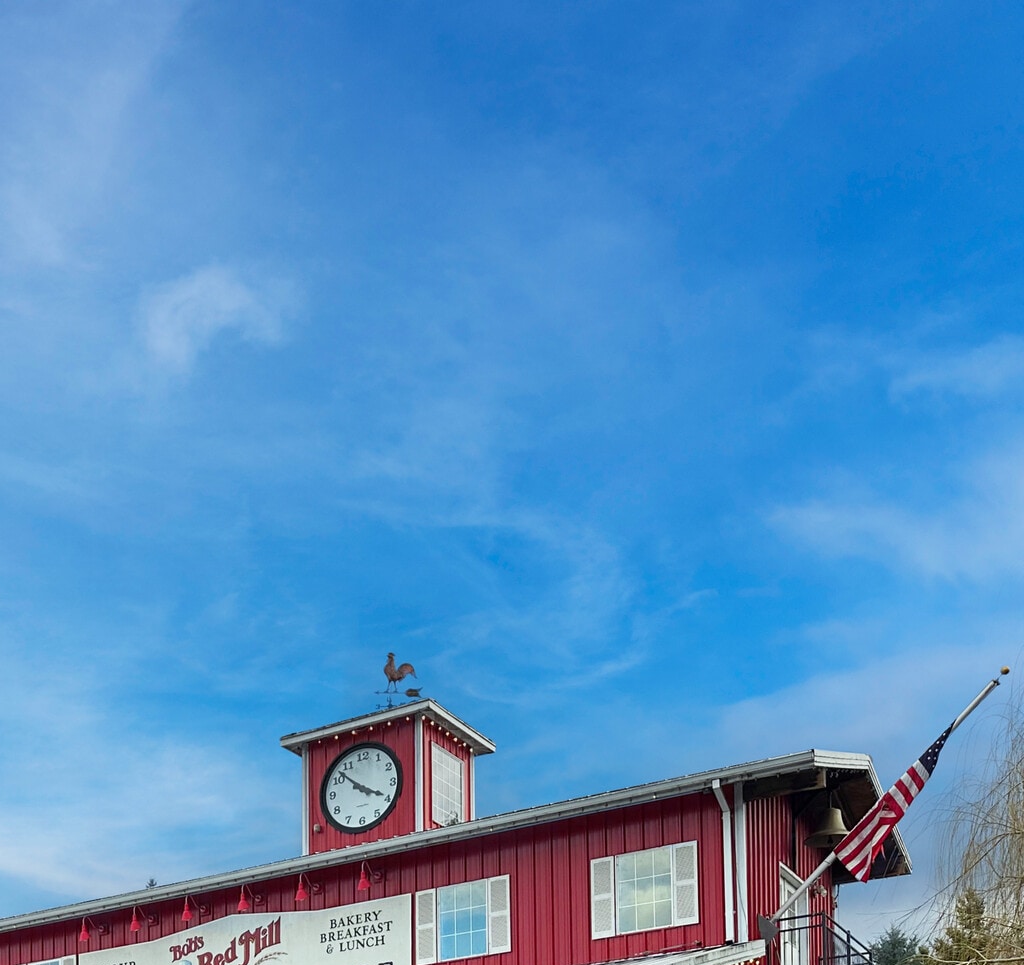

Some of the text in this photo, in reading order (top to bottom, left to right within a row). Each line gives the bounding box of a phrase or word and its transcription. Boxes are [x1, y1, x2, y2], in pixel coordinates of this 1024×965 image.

[357, 752, 369, 762] 12
[376, 753, 381, 762] 1
[343, 761, 353, 771] 11
[385, 762, 392, 771] 2
[333, 774, 345, 785] 10
[390, 777, 396, 786] 3
[330, 791, 336, 800] 9
[334, 806, 341, 814] 8
[374, 809, 381, 818] 5
[345, 816, 352, 824] 7
[359, 816, 366, 825] 6
[330, 910, 383, 929] BAKERY
[320, 921, 393, 943] BREAKFAST
[326, 935, 386, 955] & LUNCH
